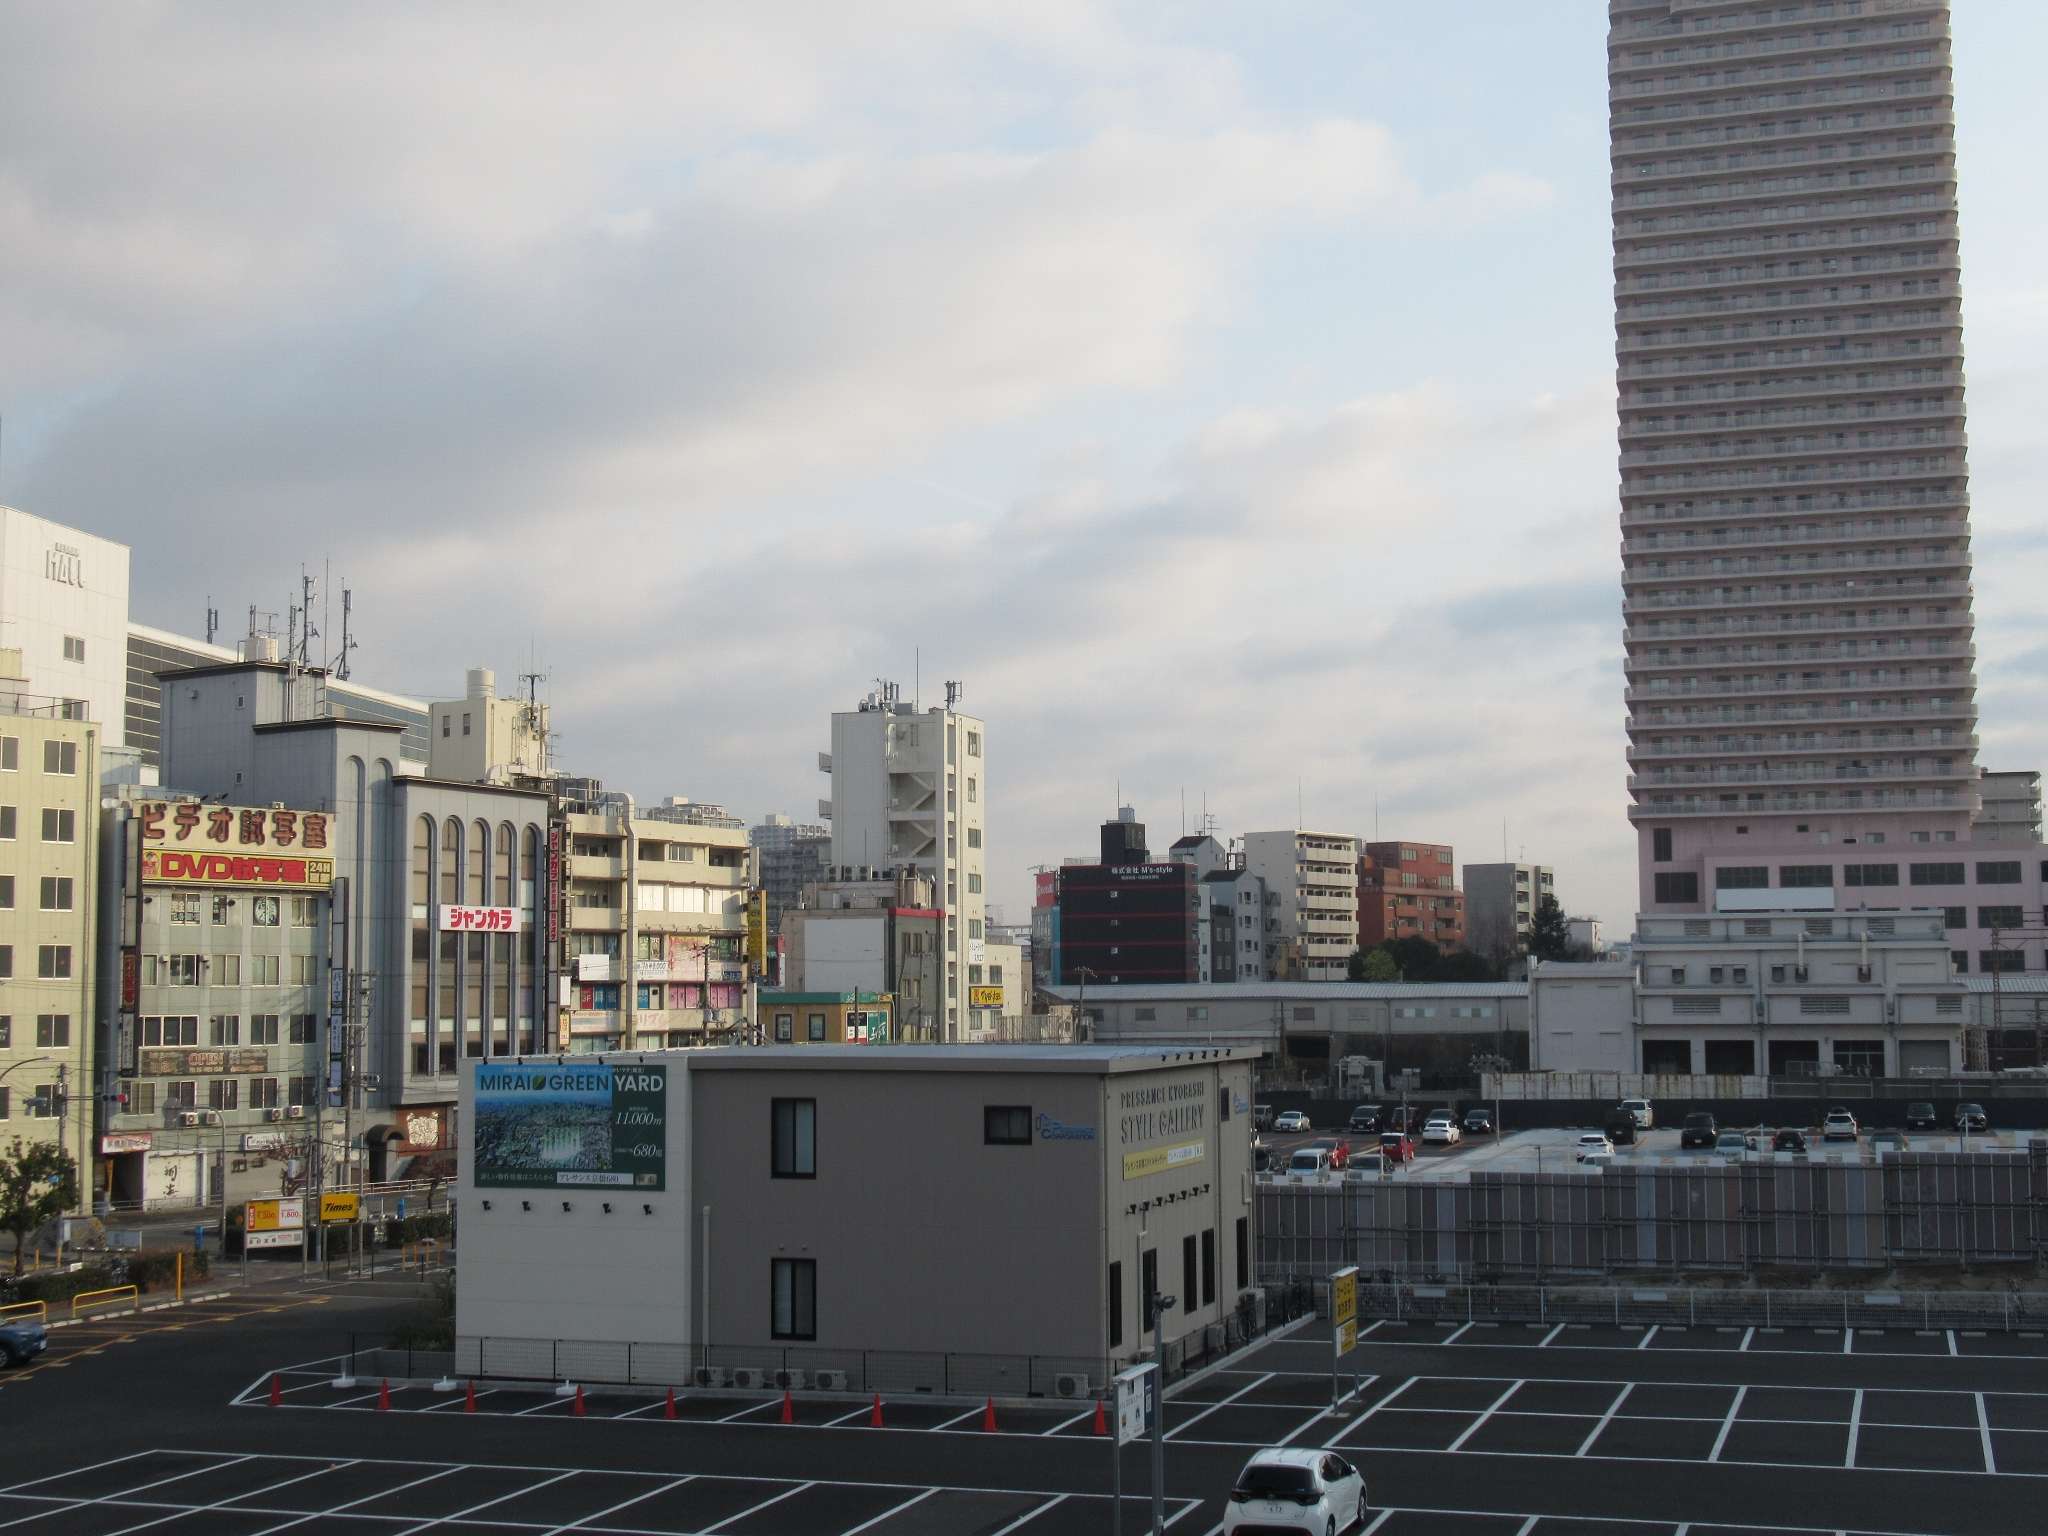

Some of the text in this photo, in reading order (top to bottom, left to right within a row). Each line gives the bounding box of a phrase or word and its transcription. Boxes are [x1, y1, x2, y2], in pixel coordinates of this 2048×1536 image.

[142, 803, 327, 849] ビデオ試写室
[450, 907, 513, 930] ジャンカラ
[480, 1074, 664, 1092] MIRAI GREEN YARD
[1159, 1104, 1204, 1137] GALLERY
[324, 1202, 353, 1213] Times
